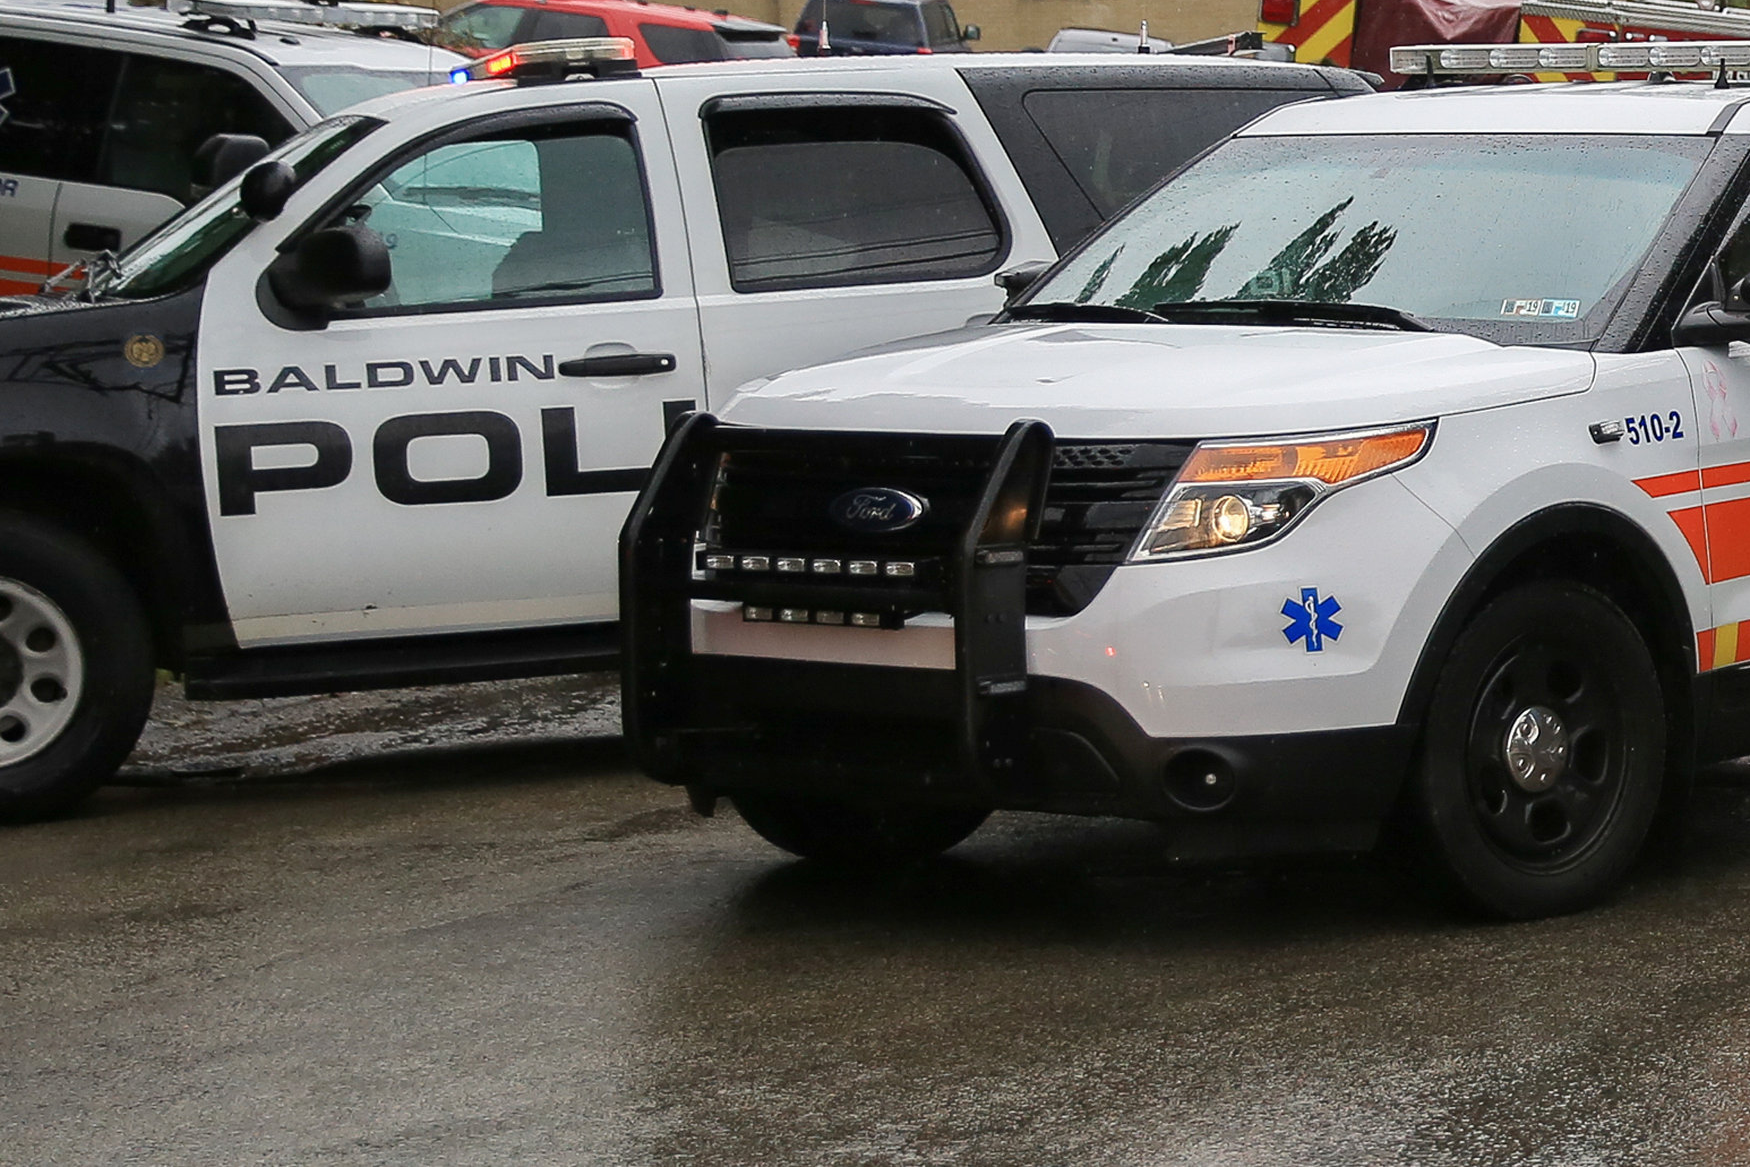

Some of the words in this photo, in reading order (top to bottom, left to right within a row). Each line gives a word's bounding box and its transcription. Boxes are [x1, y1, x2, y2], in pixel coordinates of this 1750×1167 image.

[1527, 301, 1538, 312] 19
[1565, 302, 1576, 313] 19
[213, 354, 556, 396] BALDWIN
[1624, 411, 1684, 445] 510-2
[213, 400, 697, 517] POL
[847, 494, 896, 521] Ford
